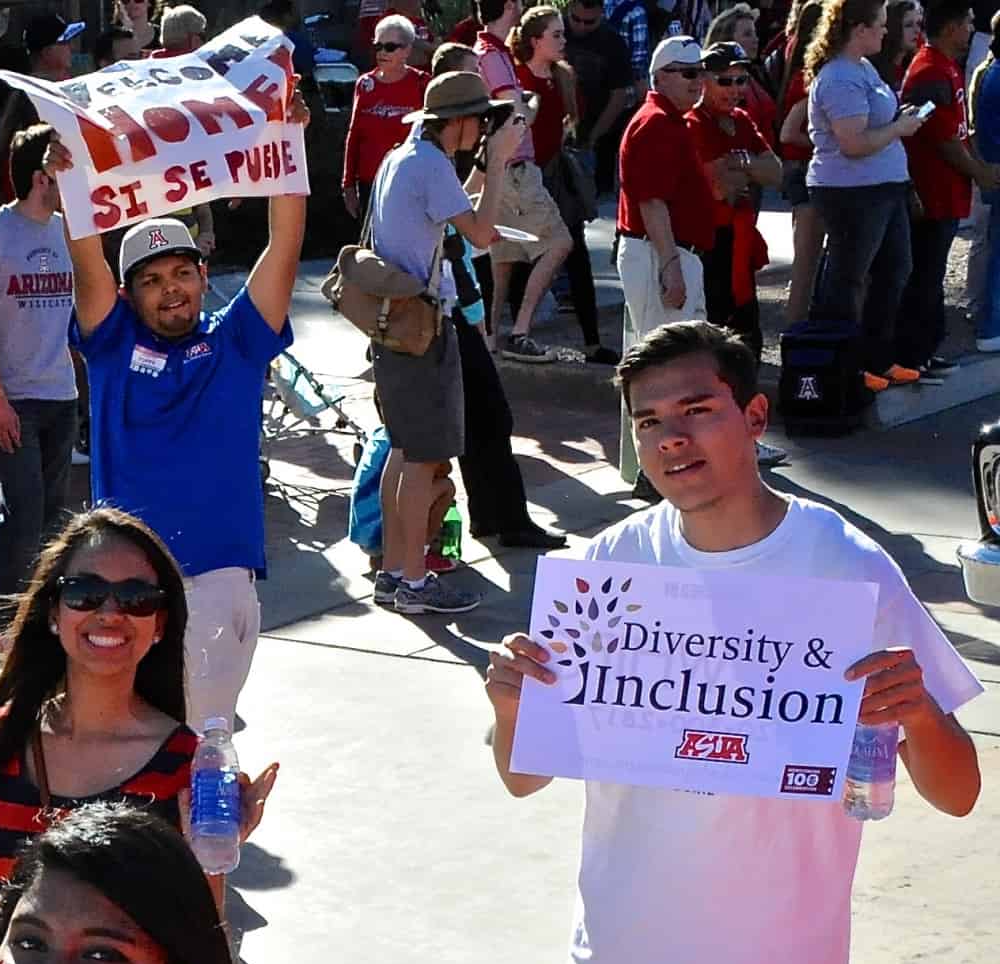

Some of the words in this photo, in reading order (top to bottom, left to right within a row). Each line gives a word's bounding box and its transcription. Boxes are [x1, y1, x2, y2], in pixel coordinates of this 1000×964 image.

[75, 45, 296, 174] HOME
[90, 180, 149, 229] SI
[163, 160, 213, 203] SE
[620, 619, 794, 674] Diversity
[802, 636, 834, 671] &
[590, 663, 845, 726] Inclusion
